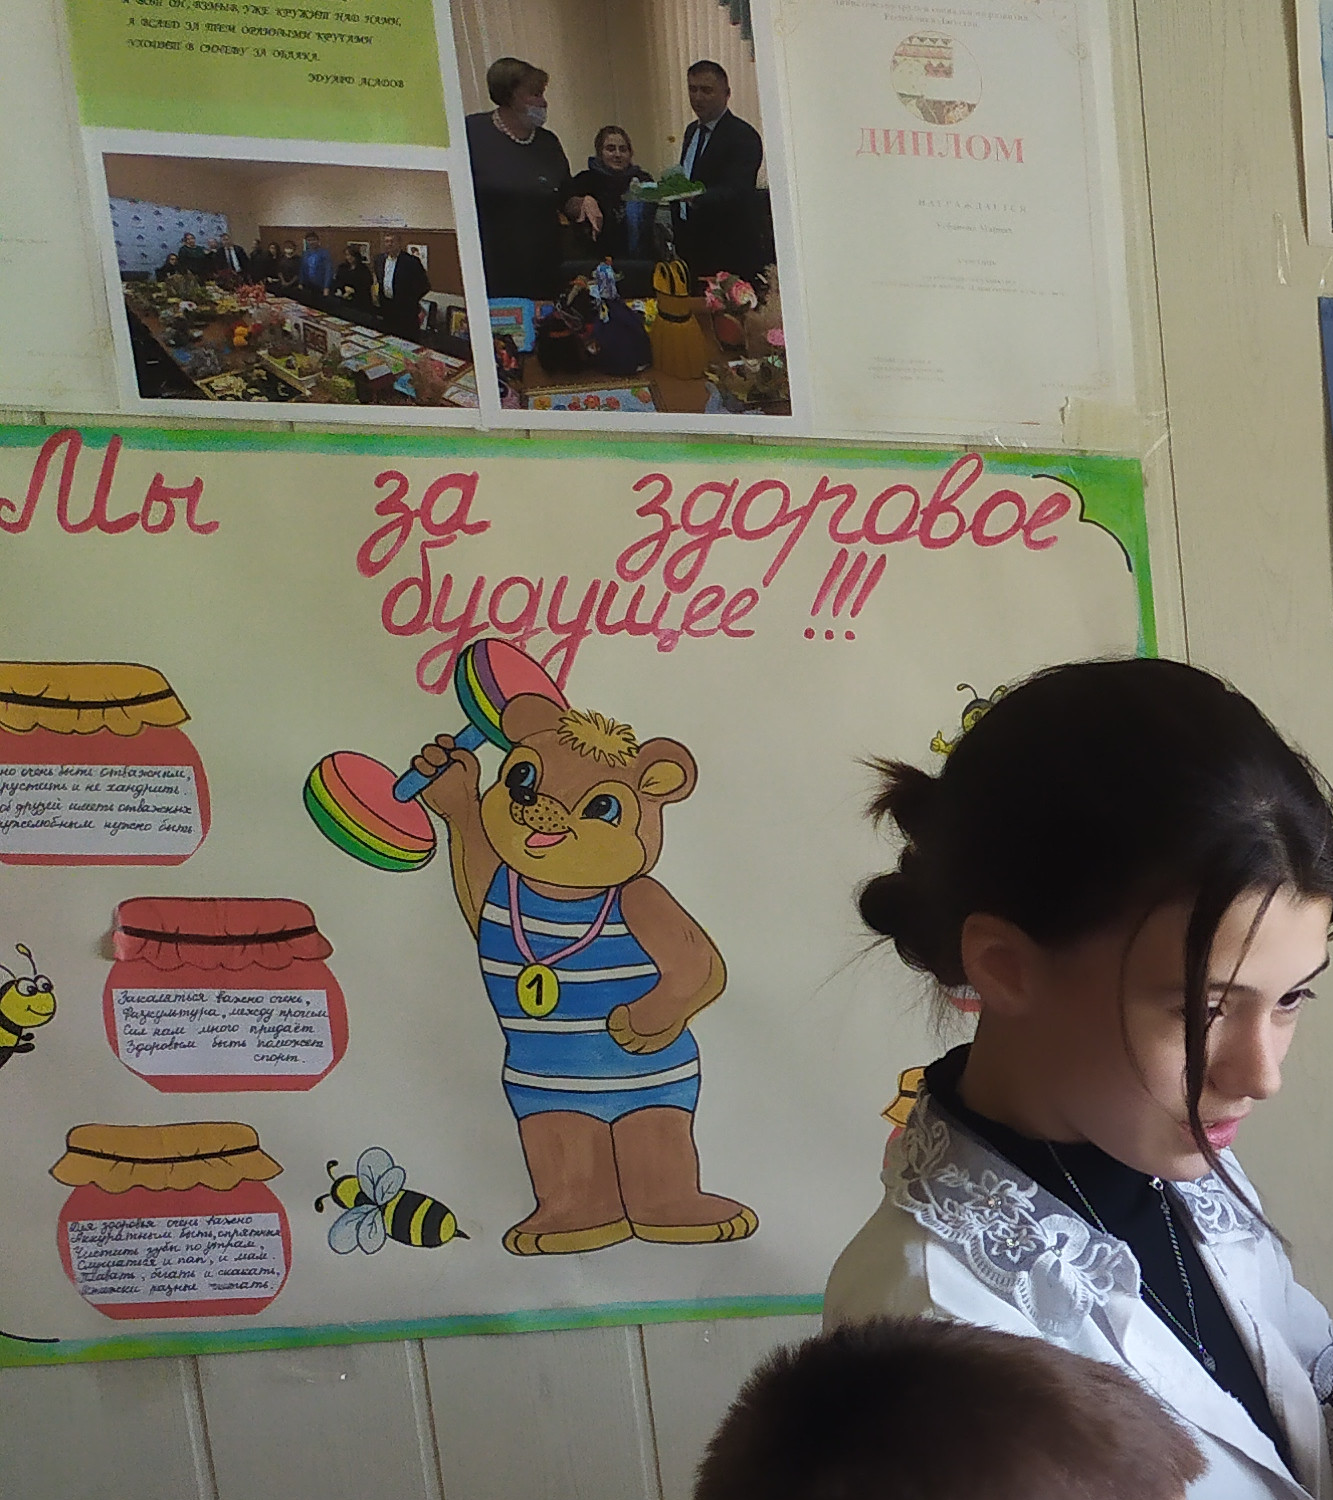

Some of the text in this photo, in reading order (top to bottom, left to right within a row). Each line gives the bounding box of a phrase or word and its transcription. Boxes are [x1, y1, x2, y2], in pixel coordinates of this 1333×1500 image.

[855, 127, 1025, 164] ДИПЛОМ
[0, 429, 1063, 592] Мы за здоровое
[380, 536, 761, 696] будущее
[215, 990, 265, 1004] важно
[525, 973, 544, 1006] 1
[198, 1024, 240, 1035] много
[126, 1036, 198, 1058] Здоровым
[211, 1036, 247, 1049] быть
